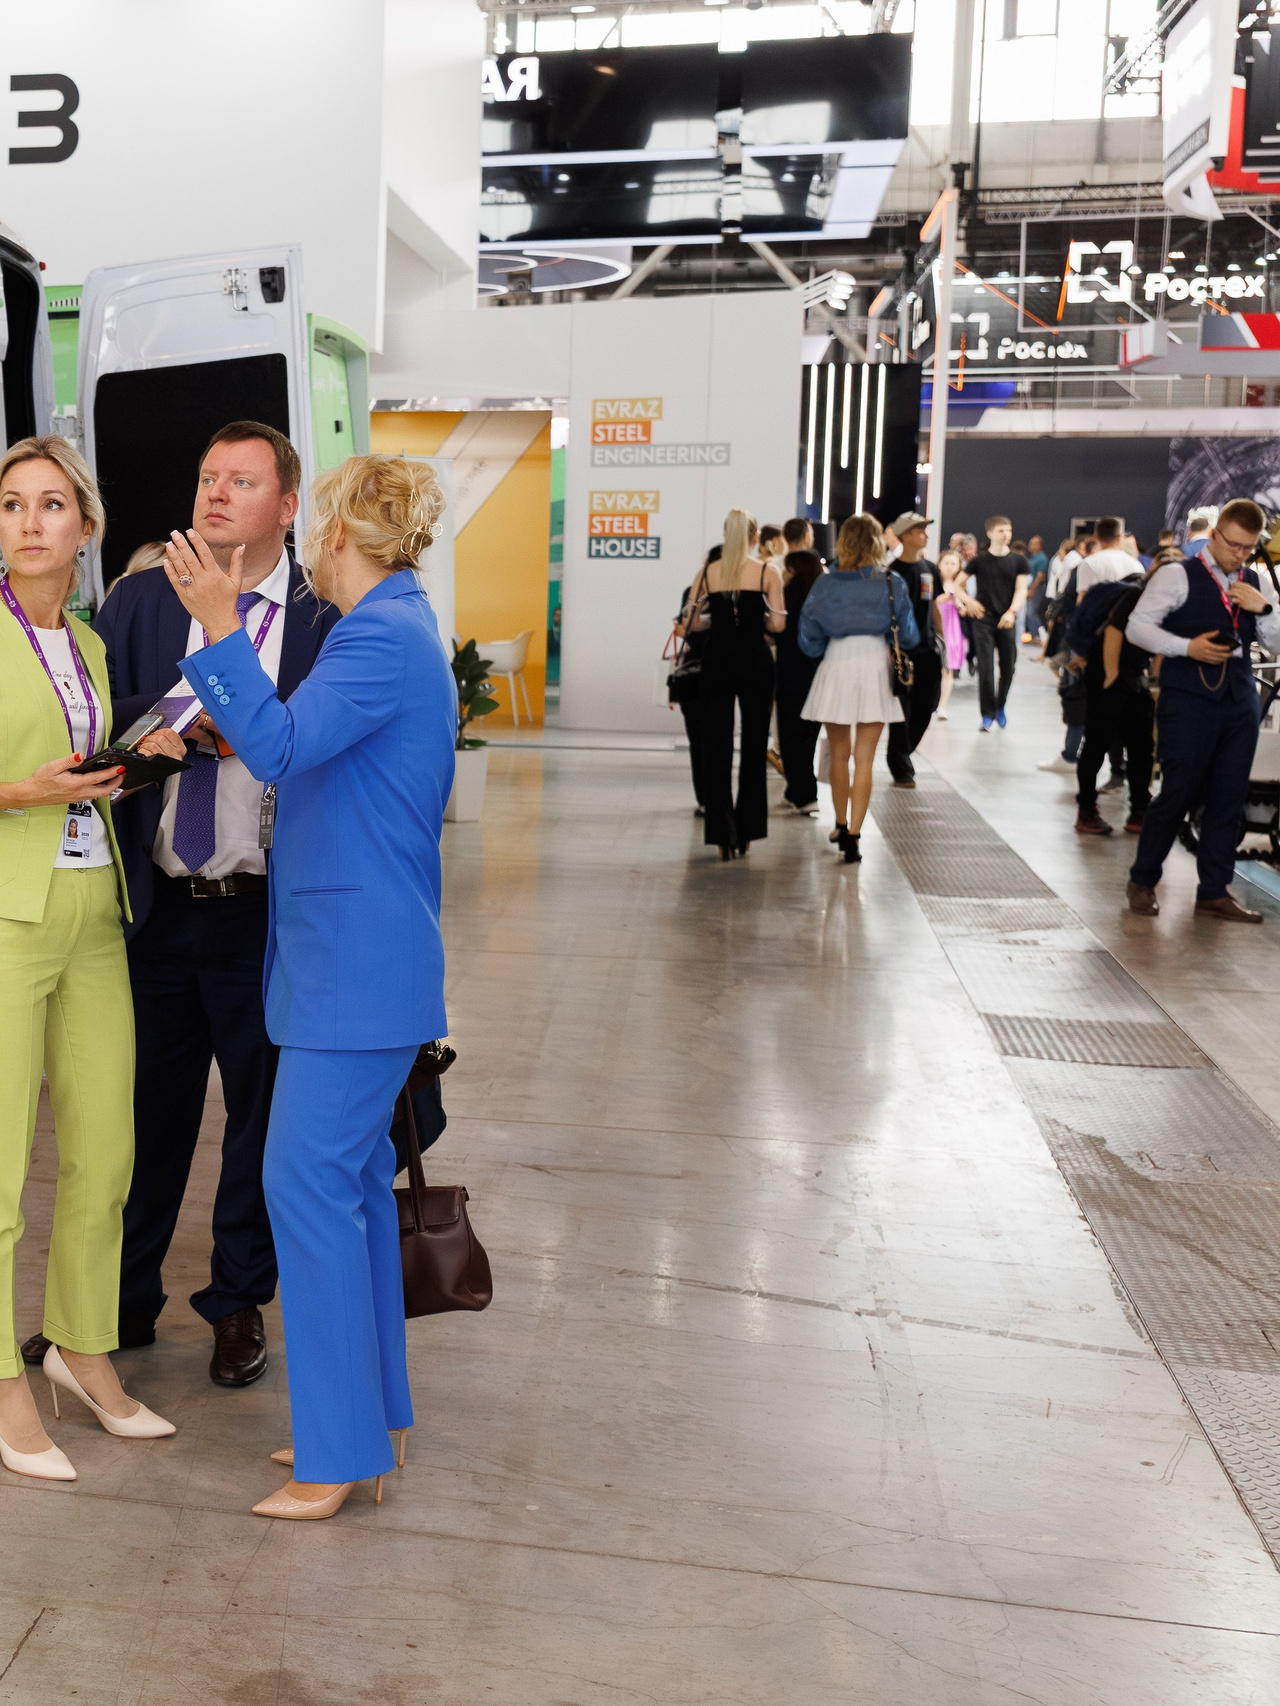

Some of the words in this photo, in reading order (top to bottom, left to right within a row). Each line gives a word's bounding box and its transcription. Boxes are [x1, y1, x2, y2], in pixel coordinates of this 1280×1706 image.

[1143, 272, 1266, 301] Ростех
[595, 400, 659, 419] EVRAZ
[593, 423, 648, 443] STEEL
[593, 445, 727, 465] ENGINEERING
[592, 492, 656, 511] EVRAZ
[590, 515, 645, 534] STEEL
[590, 538, 657, 557] HOUSE
